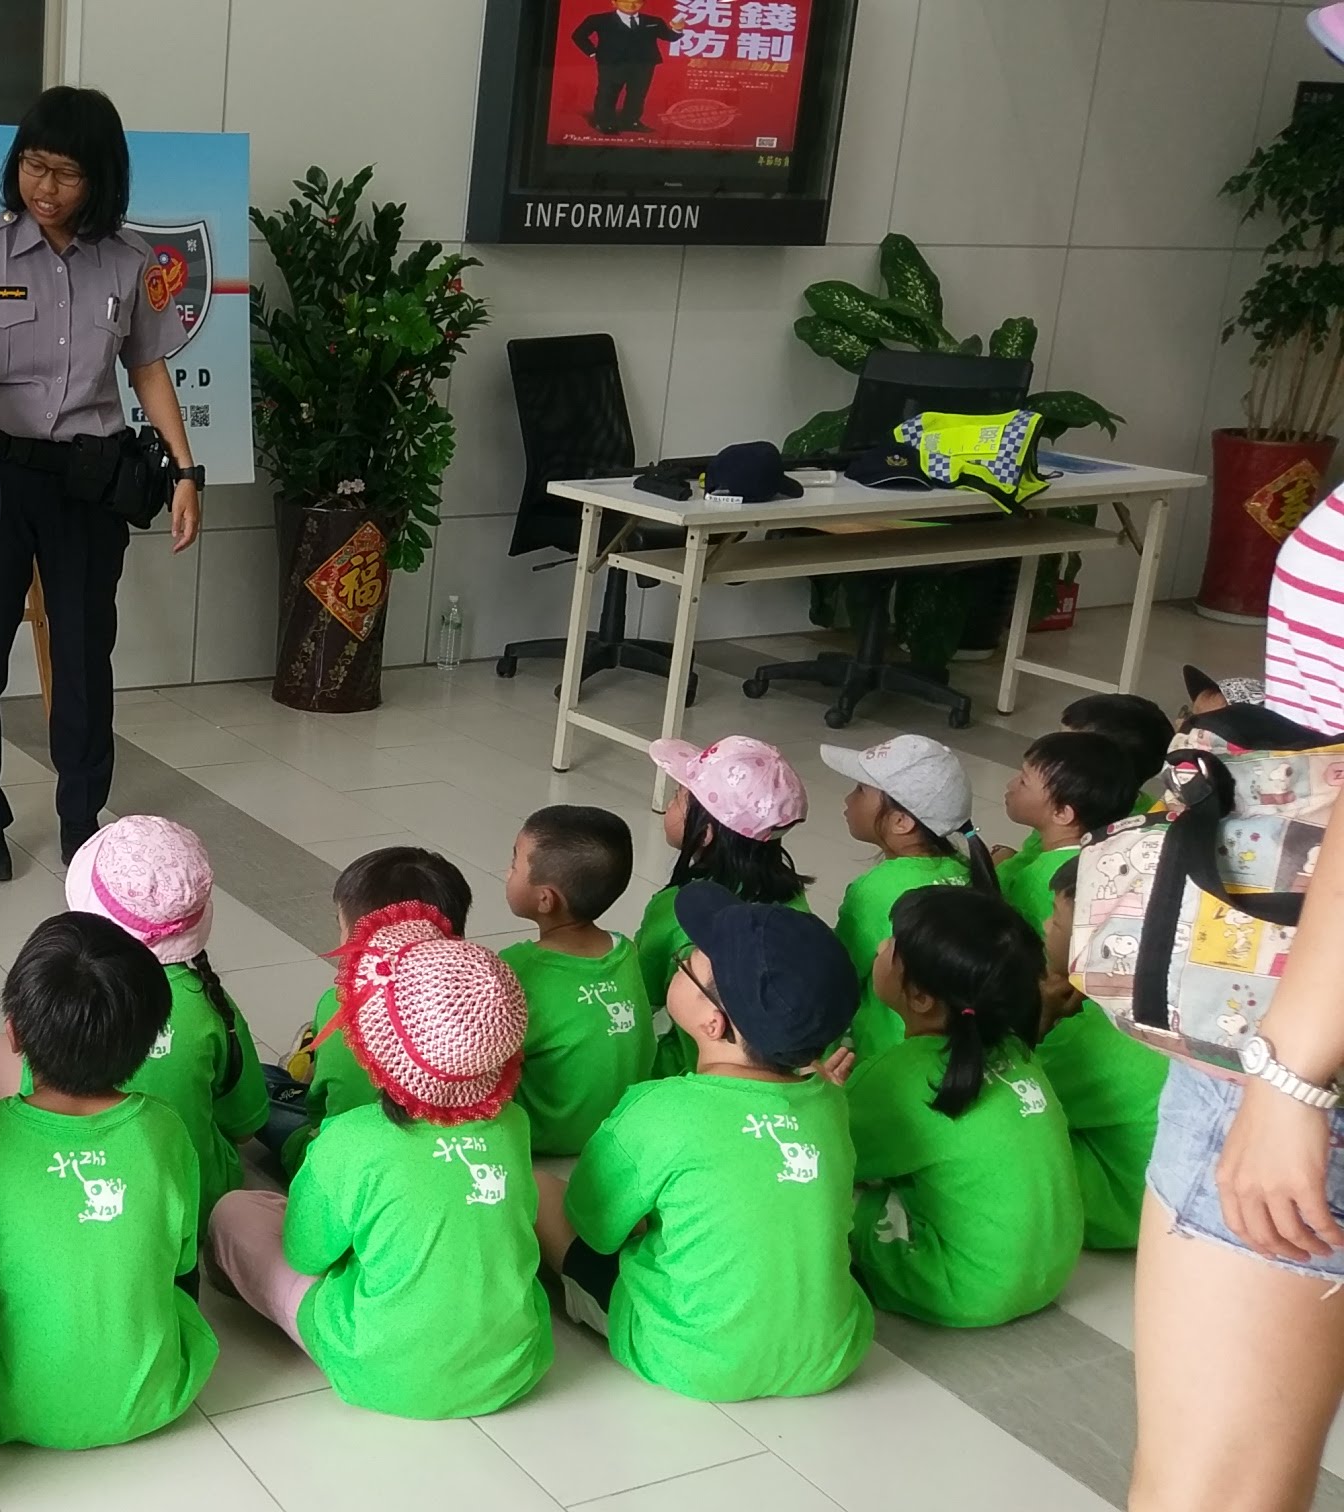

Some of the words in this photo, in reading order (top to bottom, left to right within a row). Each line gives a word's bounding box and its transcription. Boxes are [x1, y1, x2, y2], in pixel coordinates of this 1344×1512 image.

[672, 0, 797, 31] 洗錢
[668, 29, 794, 62] 防制
[523, 203, 700, 229] INFORMATION
[339, 551, 383, 609] 福
